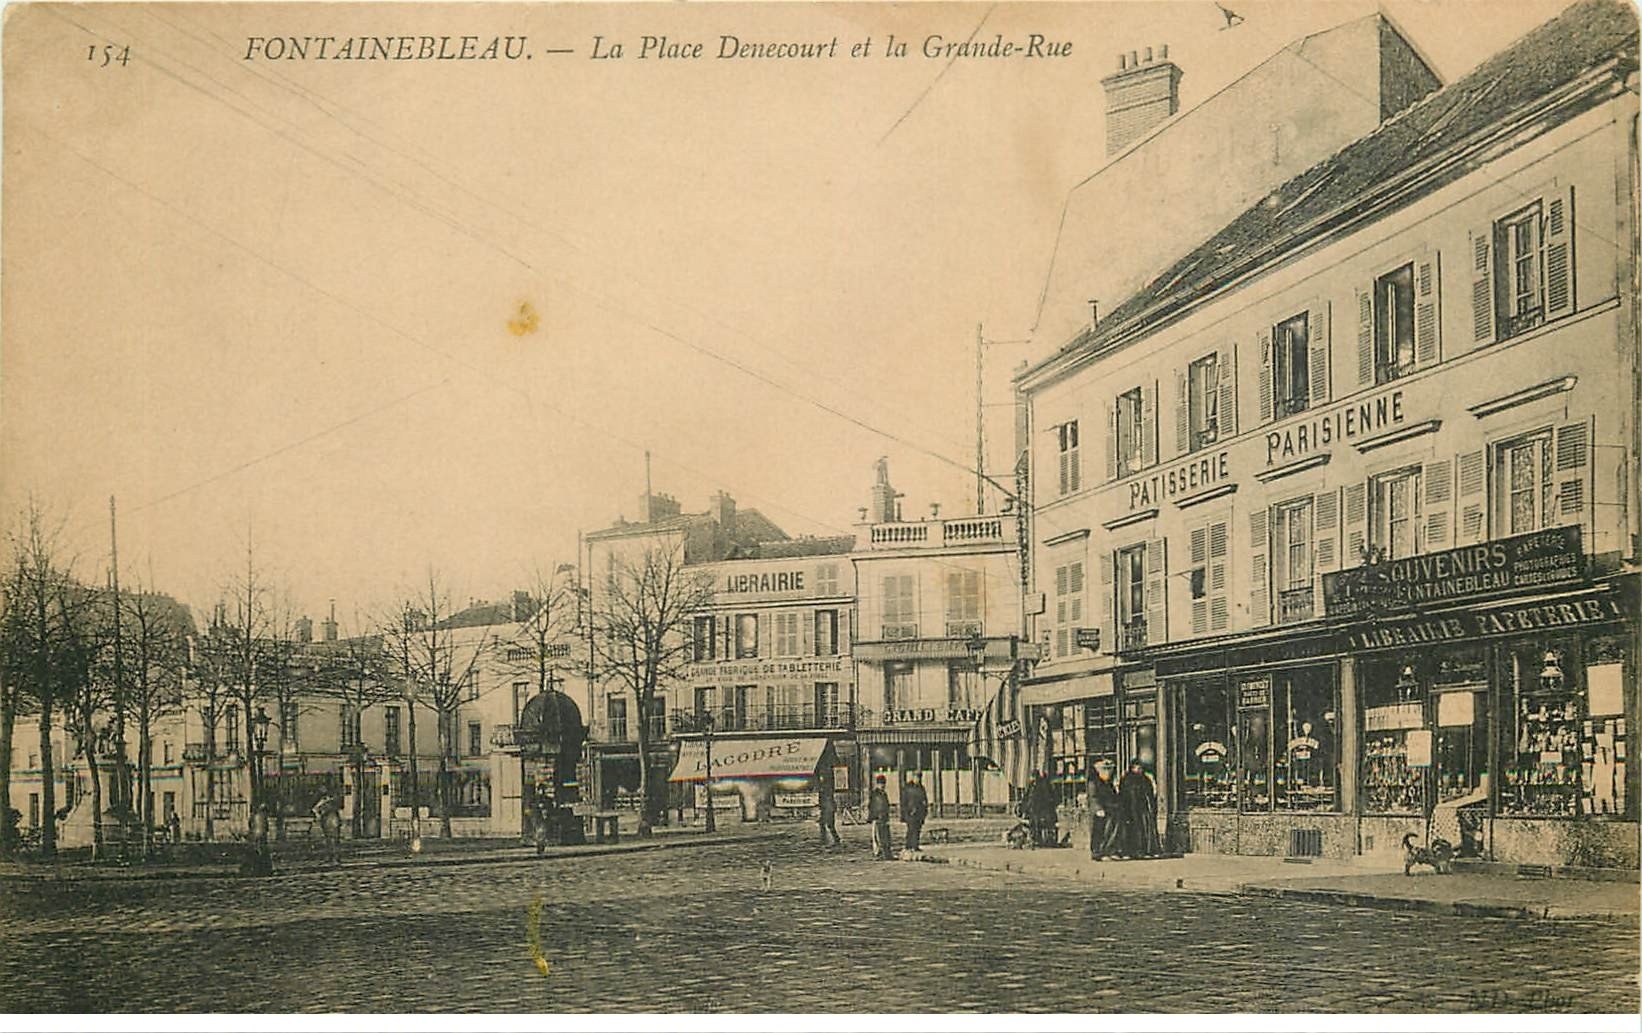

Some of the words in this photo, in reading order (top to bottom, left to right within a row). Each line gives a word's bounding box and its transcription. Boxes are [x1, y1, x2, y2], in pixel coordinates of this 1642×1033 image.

[1129, 452, 1229, 511] PATISSERIE
[1266, 391, 1404, 466] PARISIENNE
[727, 571, 805, 593] LIBRAIRIE
[1361, 619, 1465, 649] LIBRAIRIE
[1476, 600, 1605, 635] PAPETERIE
[762, 663, 775, 674] DE
[777, 660, 842, 674] TABLETTERIE
[883, 708, 935, 722] GRAND
